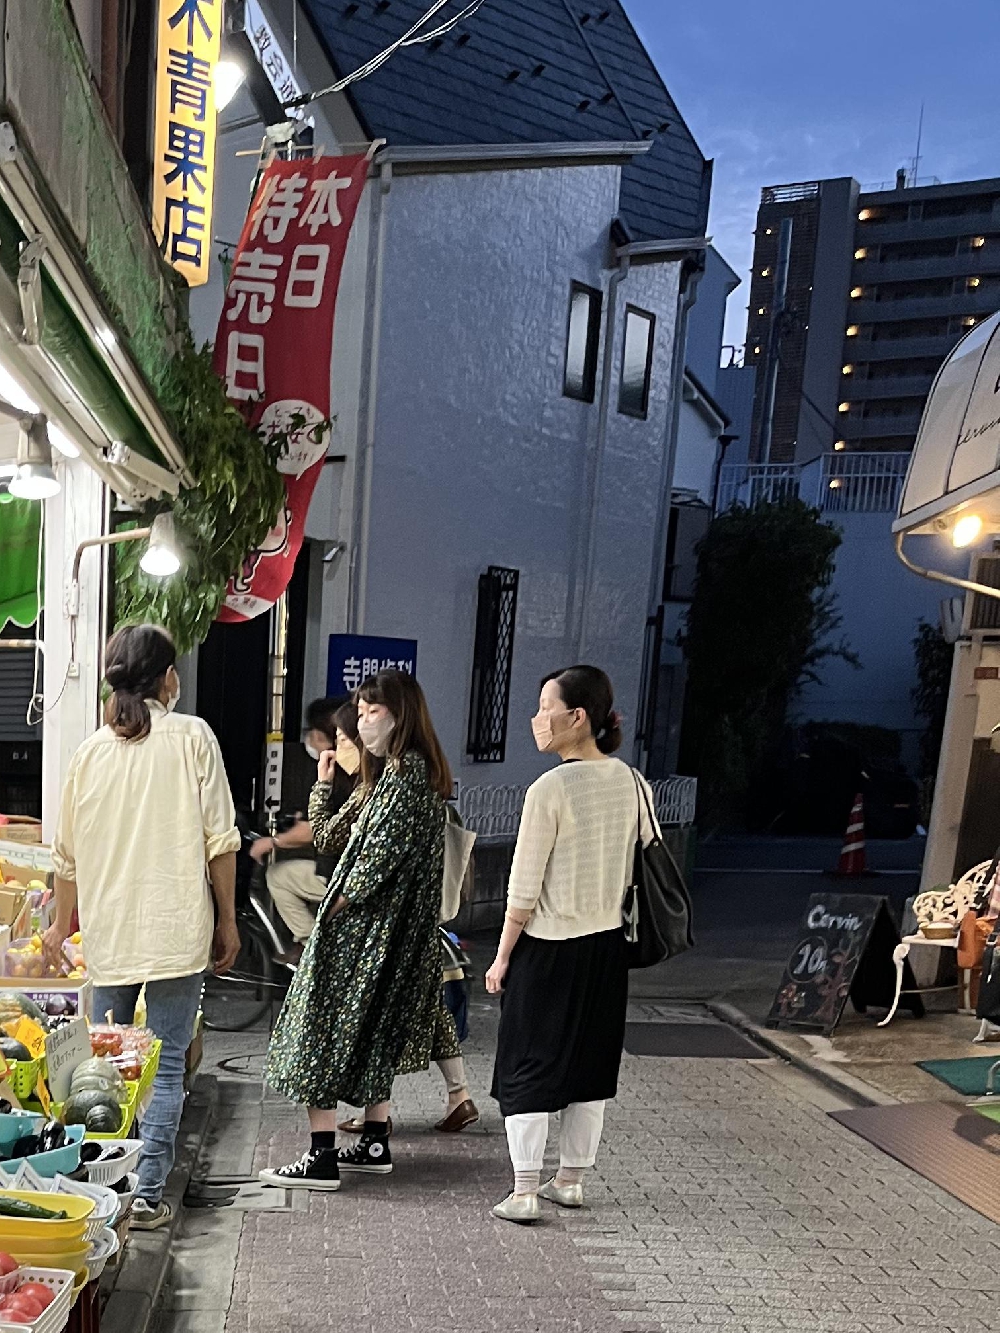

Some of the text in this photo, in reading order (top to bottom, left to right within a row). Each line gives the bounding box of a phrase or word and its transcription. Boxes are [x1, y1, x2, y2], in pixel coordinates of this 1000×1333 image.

[159, 0, 214, 268] 木青果店
[284, 170, 352, 308] 本日
[225, 173, 307, 402] 特売日
